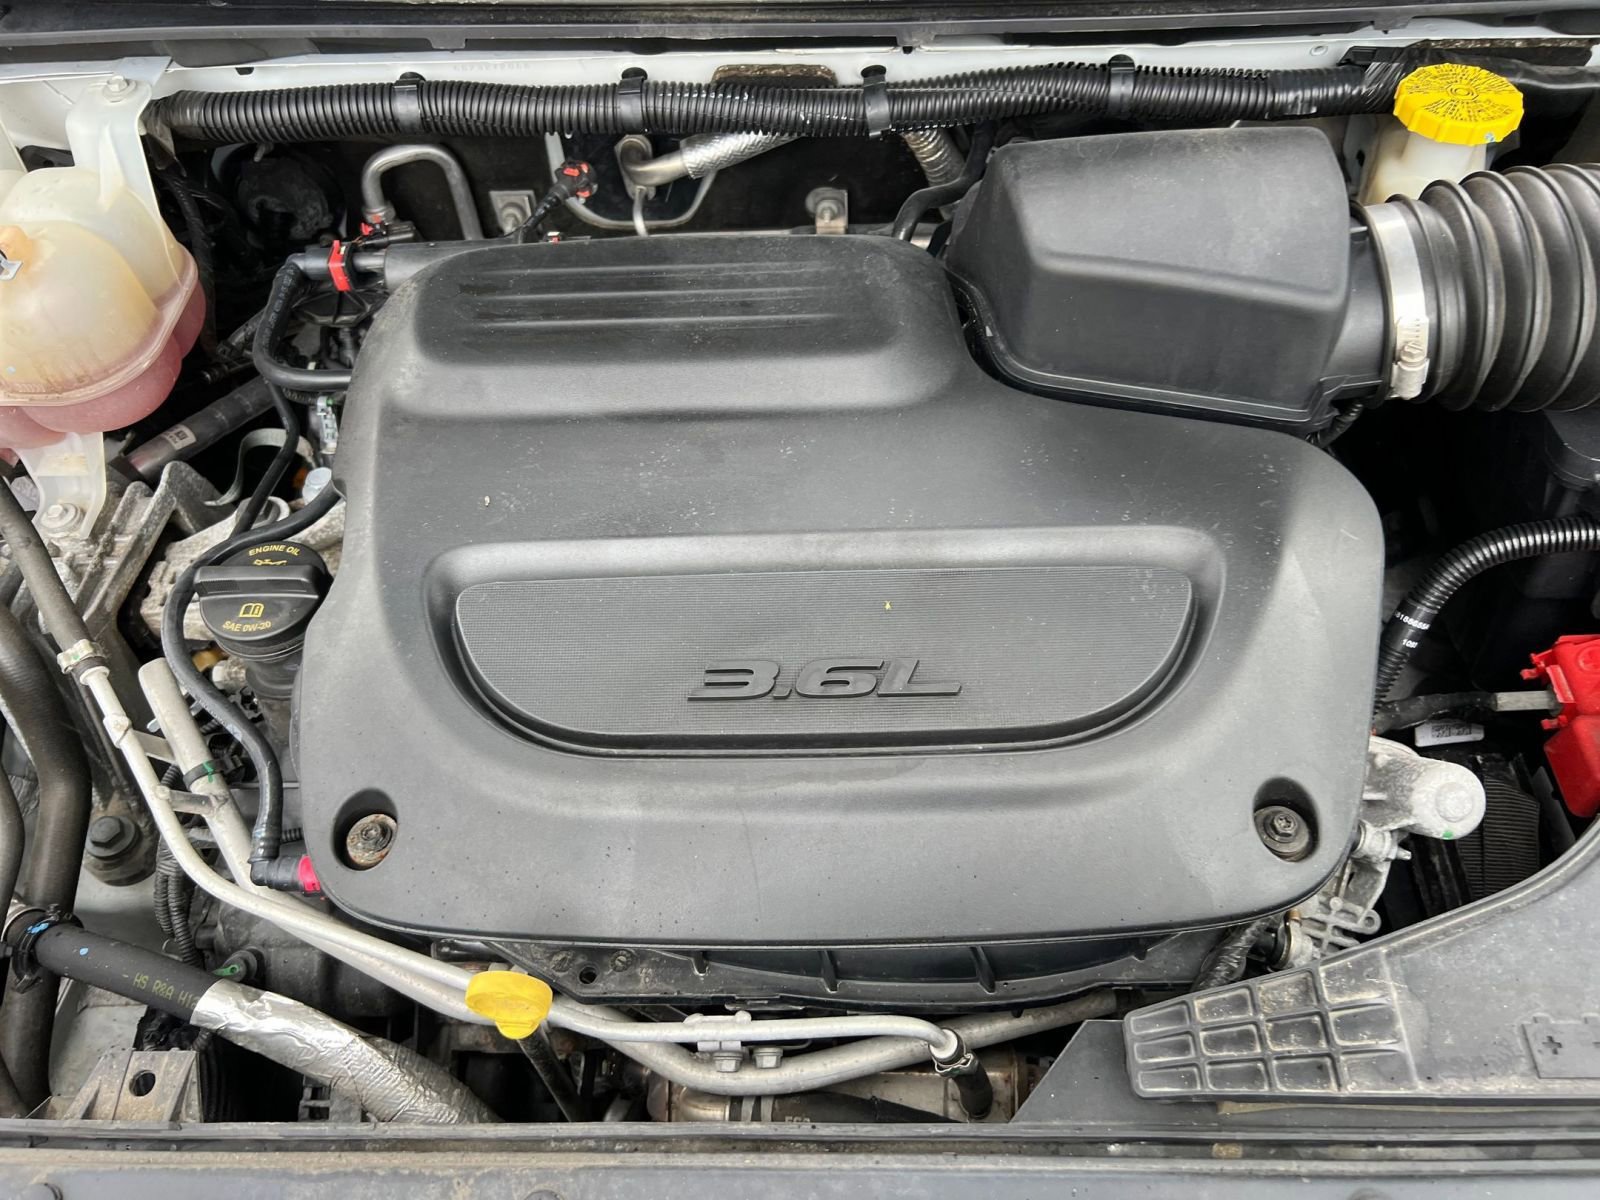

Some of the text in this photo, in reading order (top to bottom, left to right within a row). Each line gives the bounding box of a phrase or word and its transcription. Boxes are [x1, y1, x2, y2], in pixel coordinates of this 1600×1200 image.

[248, 544, 301, 556] ENGINE OIL
[222, 620, 272, 632] SAE 0W-20
[687, 657, 962, 701] 3.6L
[132, 972, 149, 990] HS
